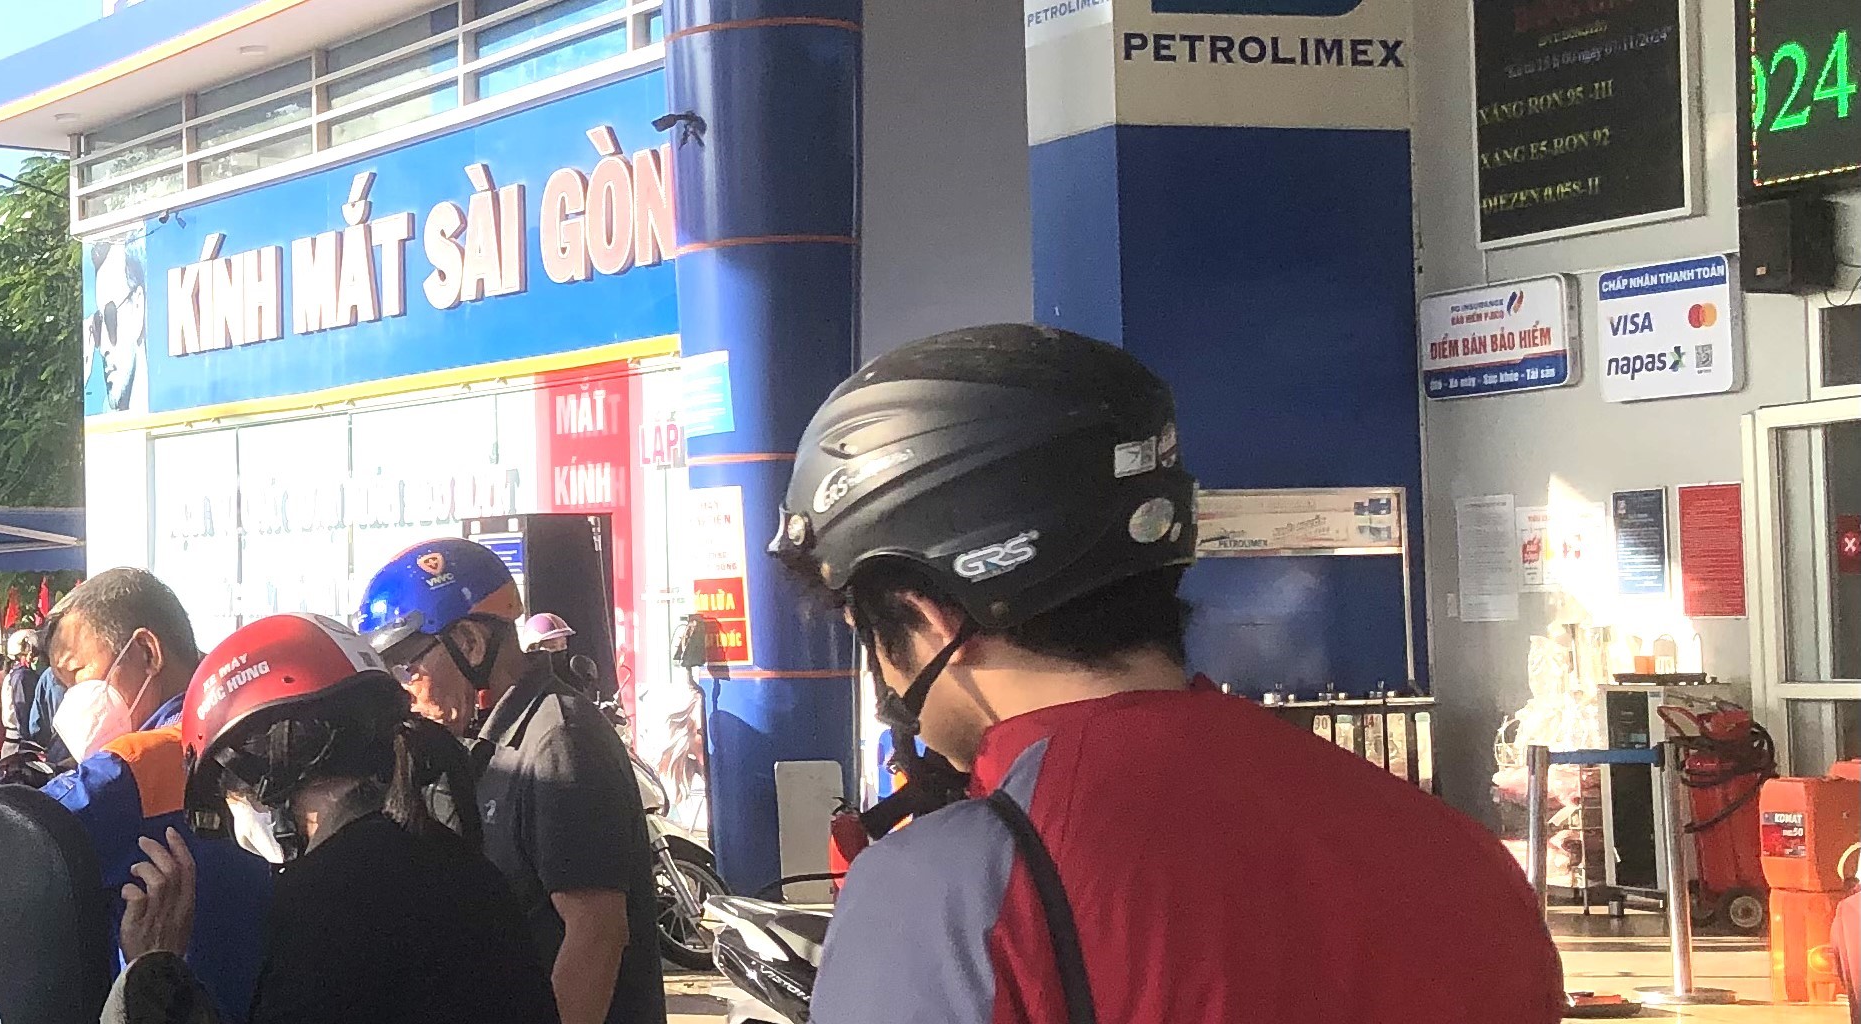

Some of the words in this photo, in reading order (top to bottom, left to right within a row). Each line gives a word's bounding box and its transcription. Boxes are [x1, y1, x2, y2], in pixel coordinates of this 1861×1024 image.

[1027, 0, 1109, 27] PETROLIM
[1123, 32, 1405, 68] PETROLIMEX
[167, 233, 283, 356] KÍNH
[291, 172, 415, 335] MẮT
[422, 163, 526, 310] SÀI
[540, 125, 676, 284] GÒN
[1601, 275, 1628, 293] CHẤP
[1629, 273, 1658, 289] NHẬN
[1659, 269, 1694, 284] THANH
[1695, 263, 1725, 279] TOÁN
[1430, 333, 1459, 360] ĐIỂM
[1462, 332, 1487, 356] BÁN
[1490, 326, 1516, 352] BẢO
[1519, 320, 1552, 349] HIỂM
[1609, 312, 1653, 336] VISA
[1606, 352, 1667, 380] napas
[554, 455, 611, 505] KÍNH
[953, 536, 1037, 578] GRS
